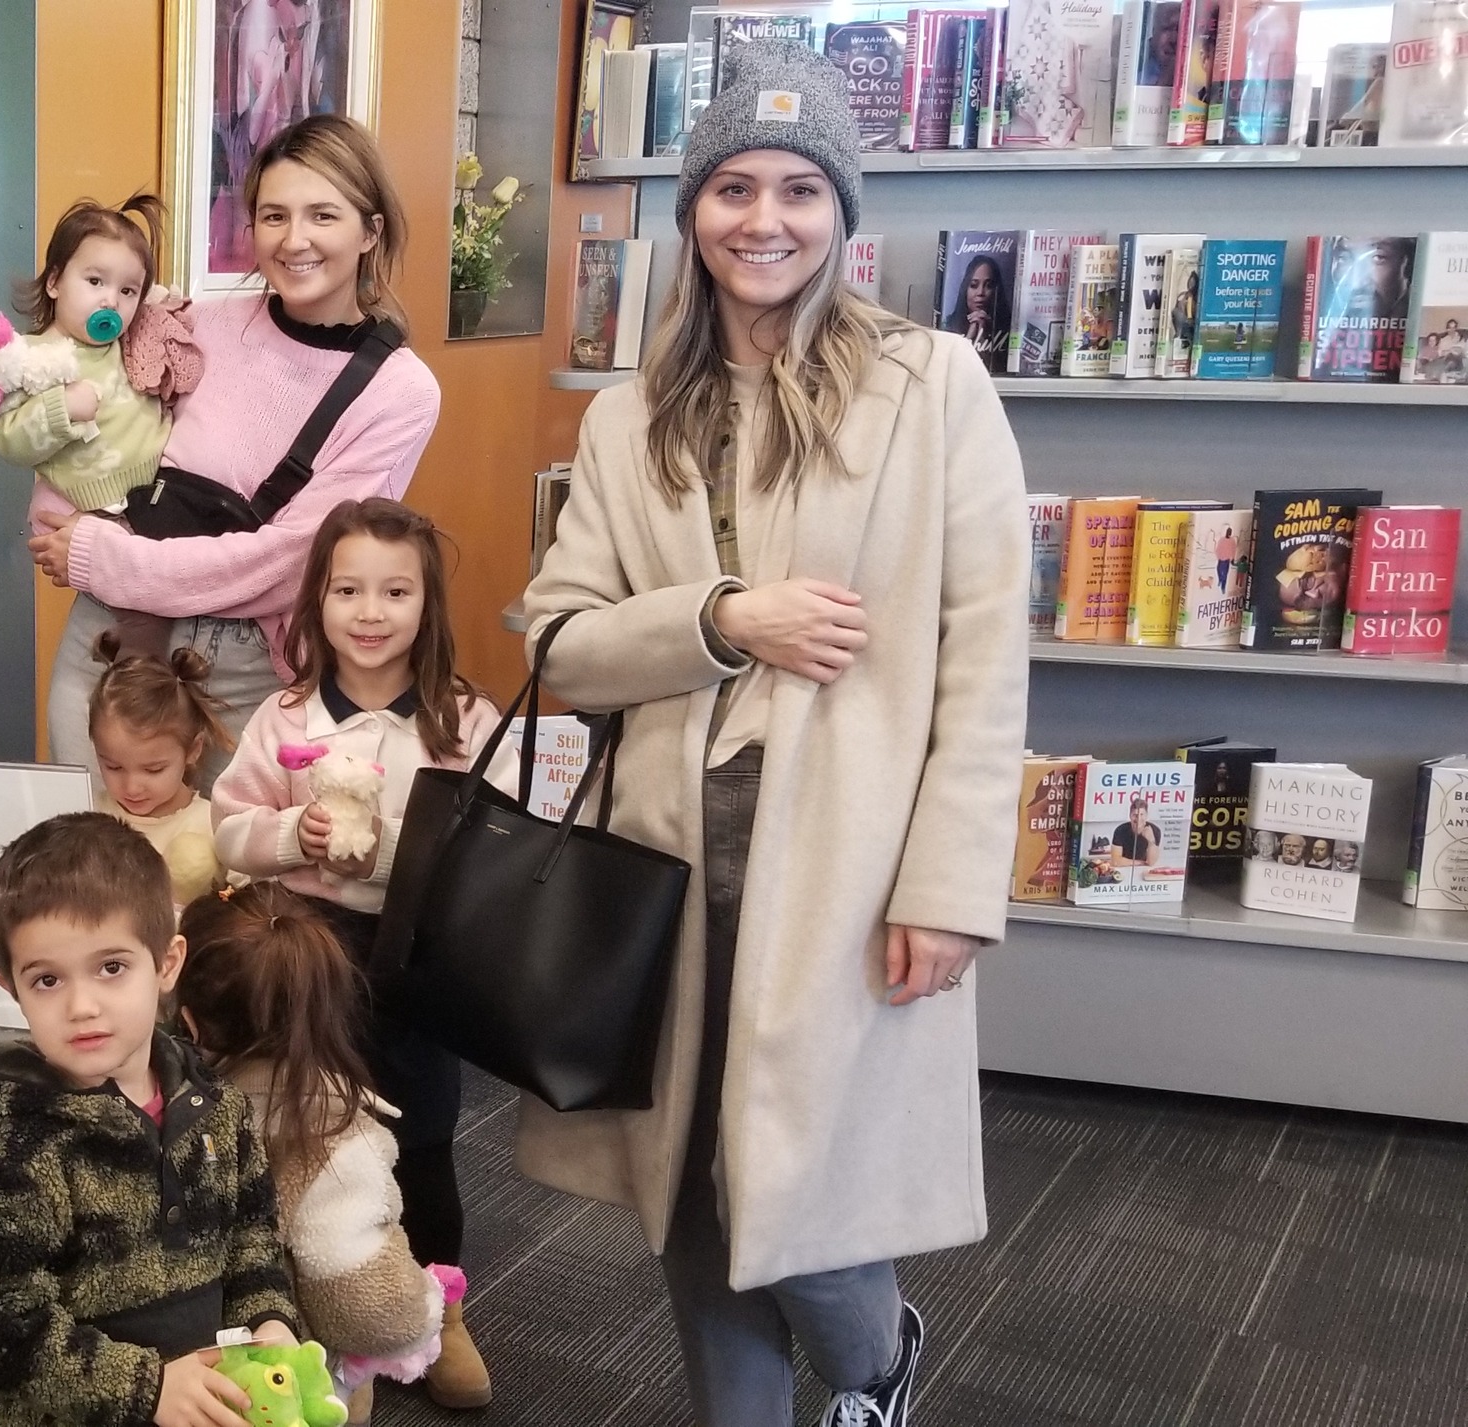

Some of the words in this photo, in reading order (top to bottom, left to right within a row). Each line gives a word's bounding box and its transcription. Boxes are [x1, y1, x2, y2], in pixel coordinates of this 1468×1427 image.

[849, 56, 888, 76] GO
[847, 78, 881, 92] ACK
[884, 82, 901, 91] TO
[876, 95, 901, 105] YOU
[864, 109, 899, 118] FROM
[1137, 103, 1163, 115] Road
[992, 238, 1013, 253] Hill
[1034, 236, 1063, 251] THEY
[582, 247, 607, 260] SEEN
[608, 247, 617, 260] &
[1087, 250, 1094, 259] A
[1217, 253, 1276, 266] SPOTTING
[1044, 254, 1057, 269] TO
[579, 263, 619, 277] UNSEEN
[844, 266, 875, 283] INE
[1085, 264, 1105, 274] THE
[1222, 269, 1269, 281] DANGER
[1216, 287, 1243, 296] before
[1244, 287, 1251, 296] it
[1305, 273, 1315, 312] SCOTTIE
[1224, 300, 1243, 311] your
[1317, 330, 1405, 348] SCOTTIE
[1285, 499, 1320, 520] SAM
[1152, 522, 1172, 531] The
[1274, 515, 1332, 539] COOKING
[1372, 518, 1427, 549] San
[1366, 561, 1447, 592] Fran-
[1210, 616, 1222, 630] BY
[1362, 607, 1442, 638] sicko
[557, 734, 584, 749] Still
[547, 768, 581, 784] After
[1101, 773, 1181, 787] GENIUS
[563, 787, 576, 801] A
[1267, 778, 1363, 801] MAKING
[1094, 790, 1186, 804] KITCHEN
[1048, 804, 1063, 815] OF
[1265, 800, 1361, 824] HISTORY
[1263, 868, 1344, 888] RICHARD
[1094, 884, 1114, 893] MAX
[1119, 884, 1169, 893] LUGAVERE
[1270, 886, 1332, 904] COHEN
